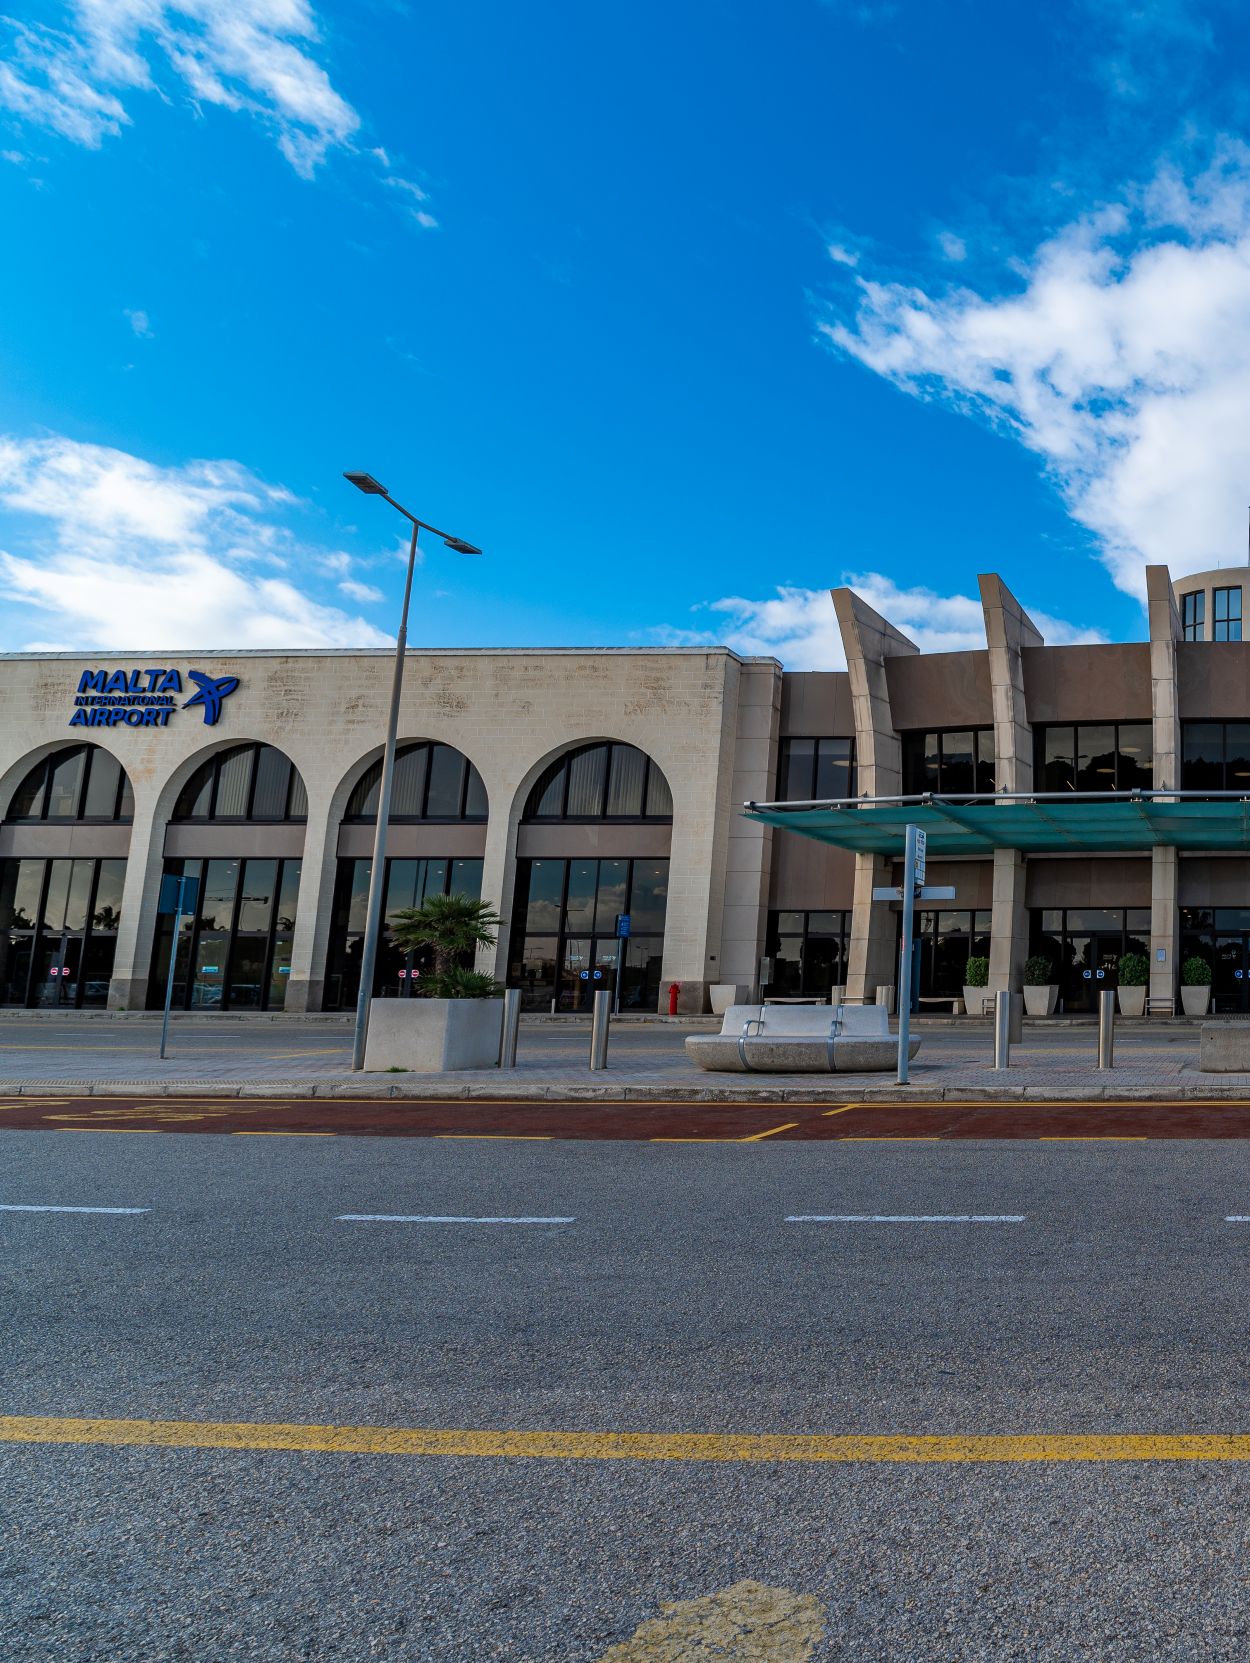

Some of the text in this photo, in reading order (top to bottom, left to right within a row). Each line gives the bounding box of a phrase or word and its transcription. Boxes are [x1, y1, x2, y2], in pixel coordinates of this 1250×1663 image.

[77, 669, 182, 693] MALTA
[74, 695, 177, 706] INTERNATIONAL
[68, 707, 177, 727] AIRPORT
